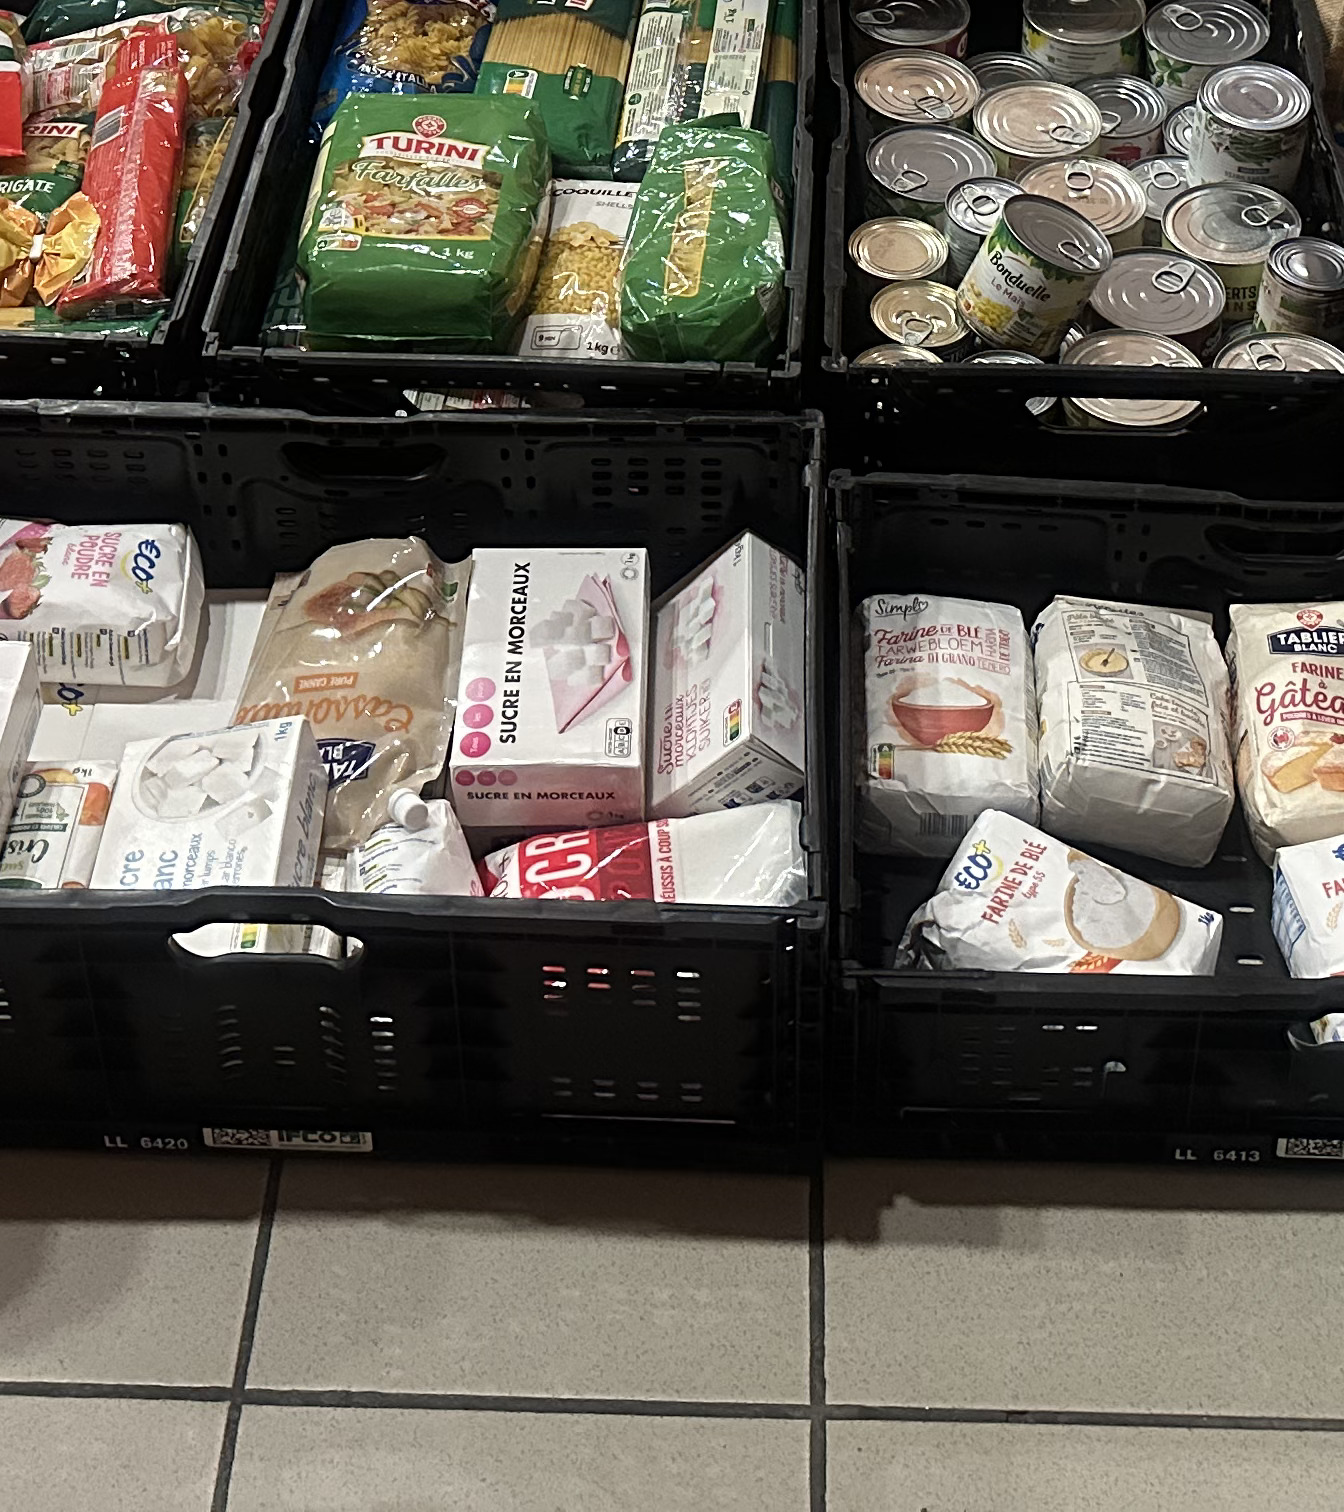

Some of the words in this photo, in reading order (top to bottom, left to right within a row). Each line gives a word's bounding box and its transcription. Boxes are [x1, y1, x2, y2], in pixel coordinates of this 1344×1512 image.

[369, 136, 479, 162] TURINI
[3, 178, 57, 195] RIGATE
[352, 160, 484, 196] Farfalles
[990, 251, 1052, 303] Bonduelle
[71, 534, 100, 580] POUDRE
[94, 531, 122, 571] SUCRE
[89, 571, 112, 588] EN
[507, 562, 531, 656] MORCEAUX
[874, 625, 939, 646] Farine
[957, 624, 982, 638] BLÉ
[878, 638, 984, 656] TARWEBLOEM
[1293, 643, 1338, 654] BLANC
[875, 654, 924, 669] Farina
[928, 652, 939, 664] DI
[941, 652, 976, 667] GRANO
[1292, 661, 1344, 681] FARINE
[504, 660, 522, 683] EN
[1318, 679, 1328, 689] à
[500, 689, 520, 744] SUCRE
[467, 791, 510, 801] SUCRE
[514, 791, 533, 801] EN
[536, 791, 616, 801] MORCEAUX
[1020, 838, 1048, 862] BLÉ
[1009, 860, 1034, 876] DE
[981, 875, 1023, 925] FARINE
[103, 1134, 128, 1149] LL
[140, 1136, 190, 1151] 6420
[1172, 1147, 1197, 1161] LL
[1211, 1148, 1259, 1162] 6413
